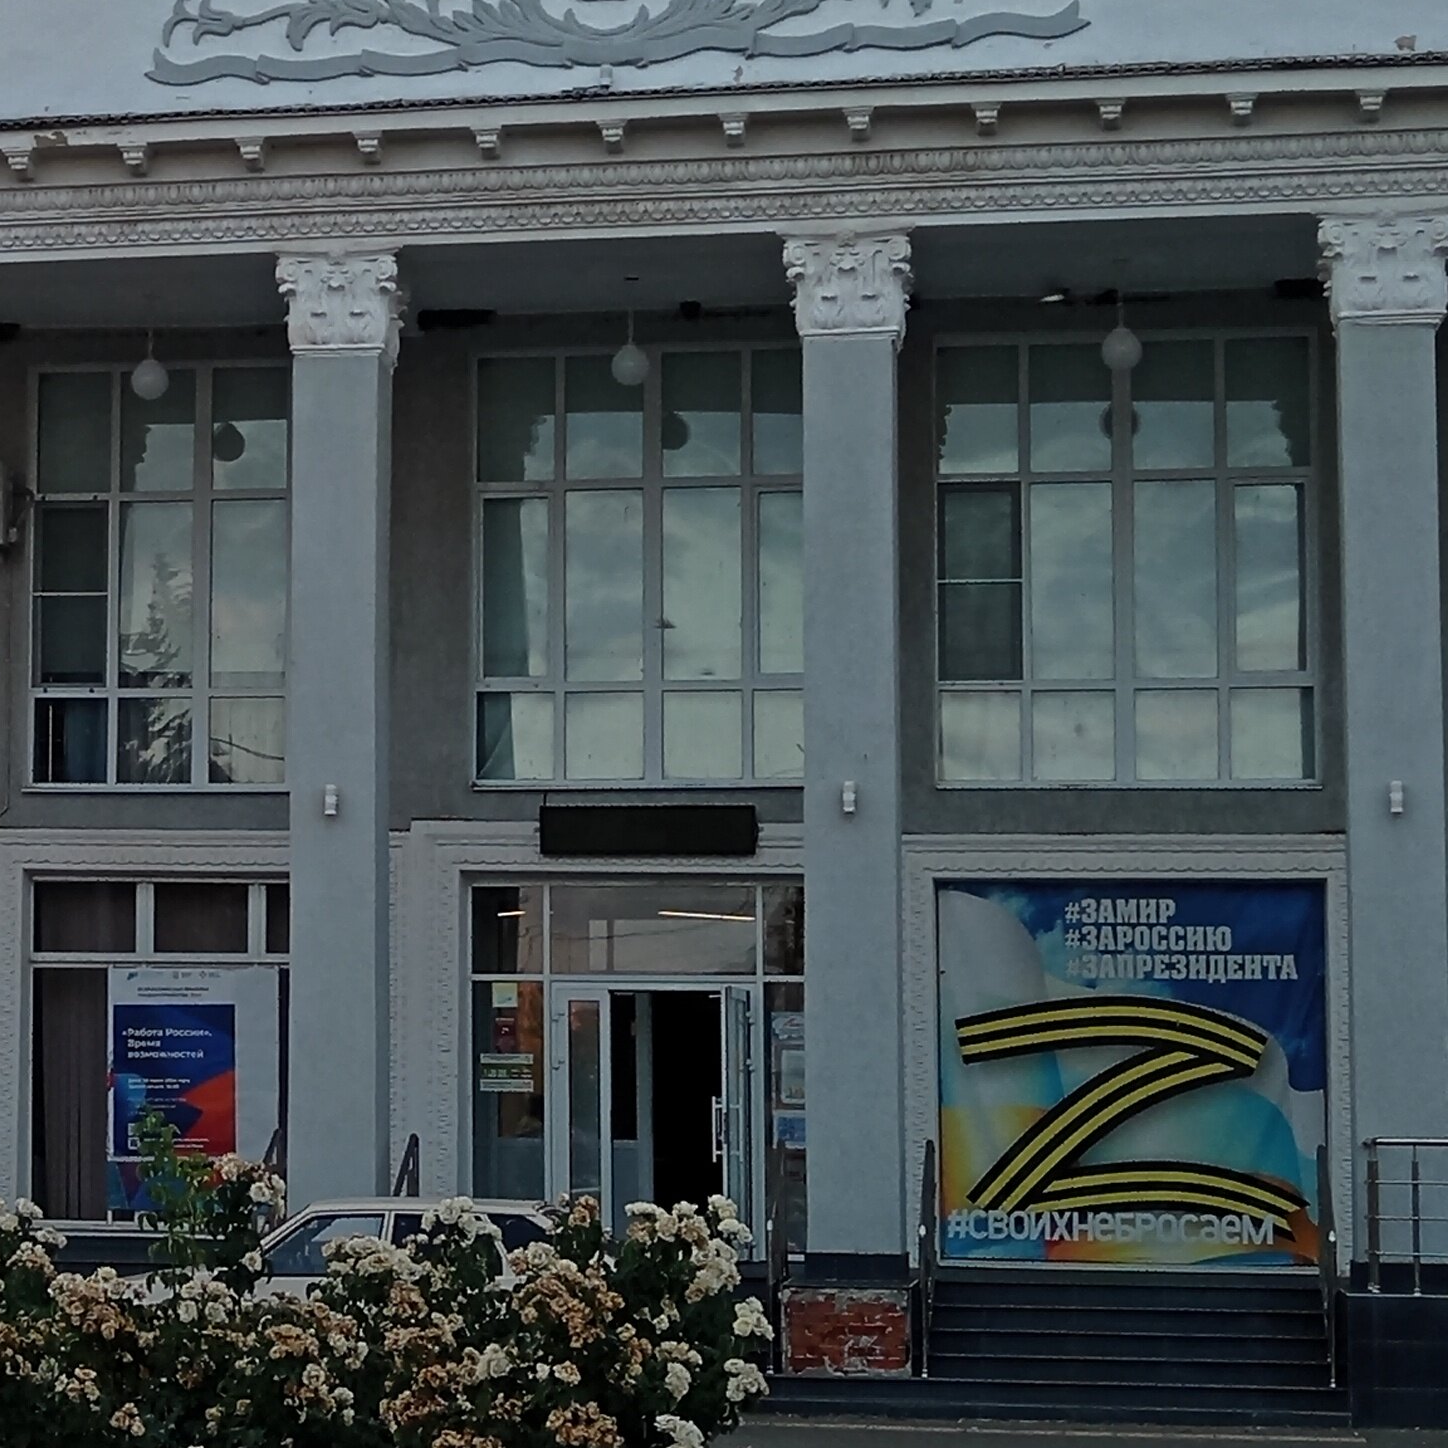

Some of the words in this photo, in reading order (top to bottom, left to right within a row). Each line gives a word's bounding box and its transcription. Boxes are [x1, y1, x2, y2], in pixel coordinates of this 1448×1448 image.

[1064, 897, 1177, 925] #ЗАМИР
[1064, 925, 1233, 952] #ЗАРОССИЮ
[1064, 953, 1299, 983] #ЗАПРЕЗИДЕНТА
